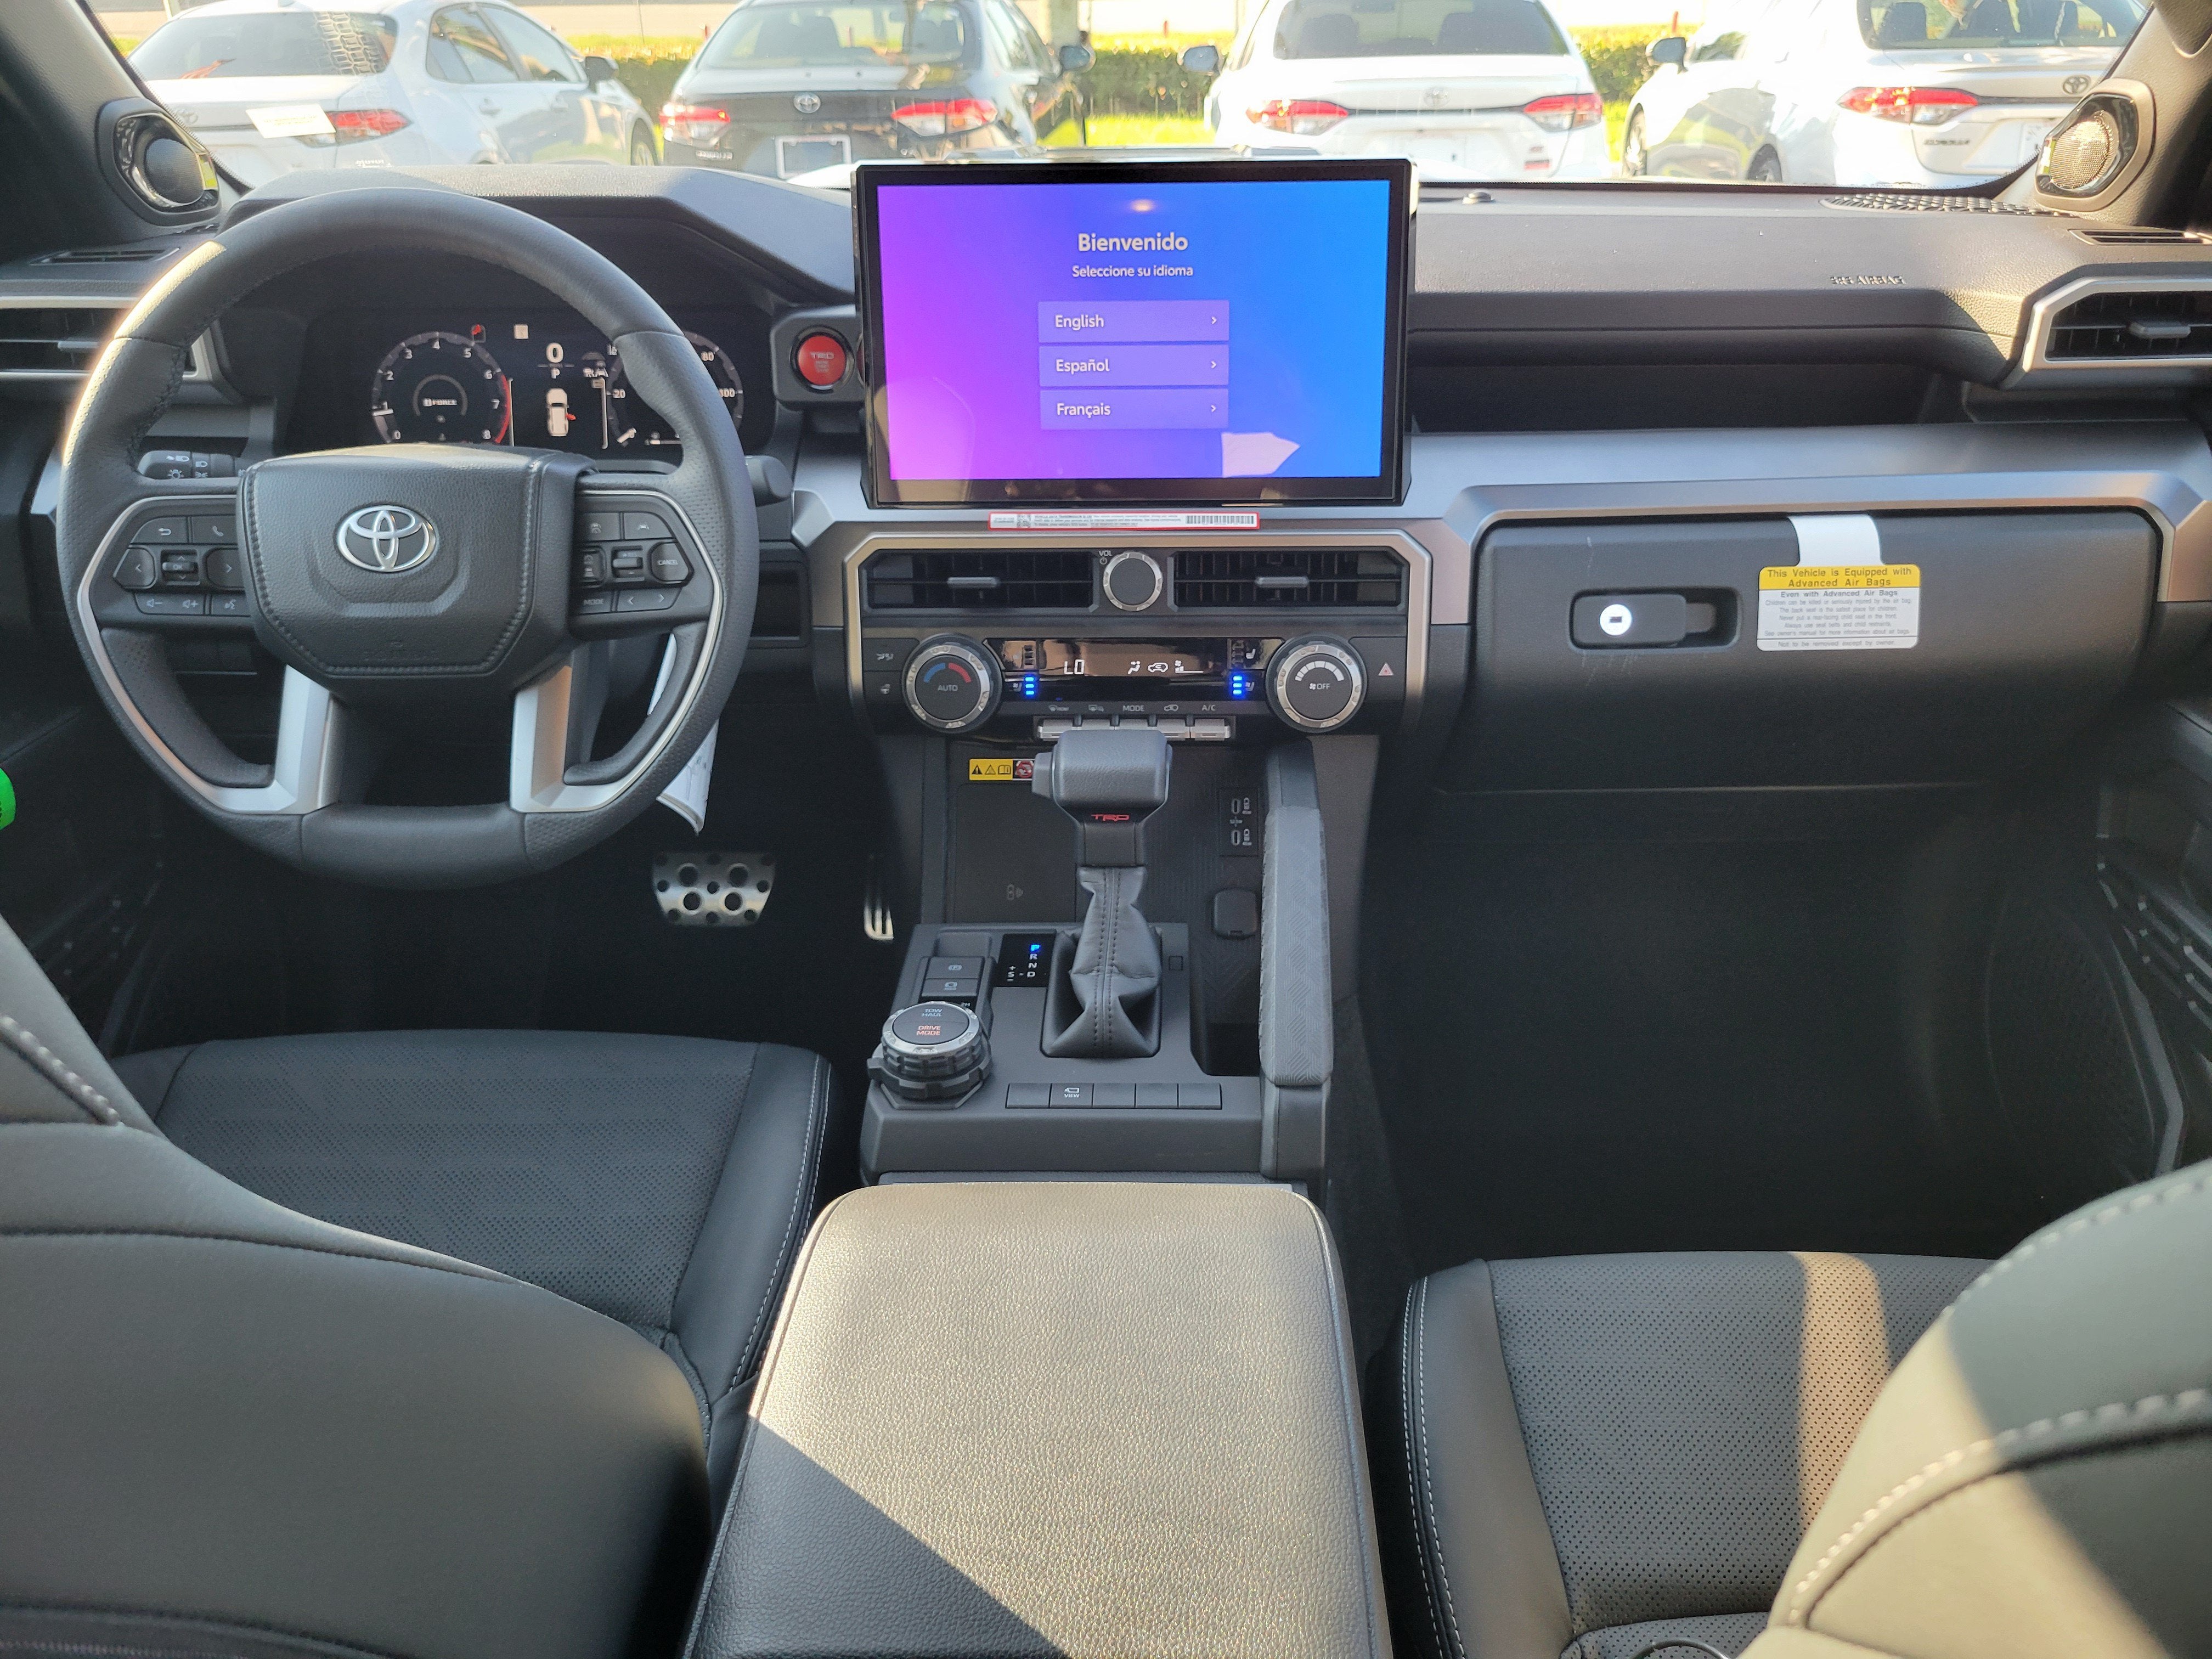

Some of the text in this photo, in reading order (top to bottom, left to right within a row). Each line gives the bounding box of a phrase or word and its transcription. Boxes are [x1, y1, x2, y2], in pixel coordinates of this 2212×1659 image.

[1078, 232, 1188, 251] Bienvenido
[1072, 264, 1193, 277] Seleccione su idioma
[1055, 314, 1104, 330] English
[432, 340, 440, 350] 4
[405, 348, 413, 359] 3
[463, 348, 472, 358] 5
[546, 343, 564, 363] 0
[701, 351, 714, 362] 80
[1056, 358, 1110, 375] Español
[386, 370, 394, 380] 2
[484, 369, 492, 380] 6
[551, 368, 560, 379] P
[612, 389, 626, 399] 20
[491, 401, 500, 409] 7
[1057, 402, 1111, 418] Français
[393, 430, 401, 439] 0
[483, 429, 491, 439] 8
[1792, 569, 1826, 577] Vehicle
[1844, 568, 1887, 578] Equipped
[1788, 579, 1838, 588] Advanced
[1866, 578, 1891, 587] Bags
[1064, 659, 1085, 675] LO
